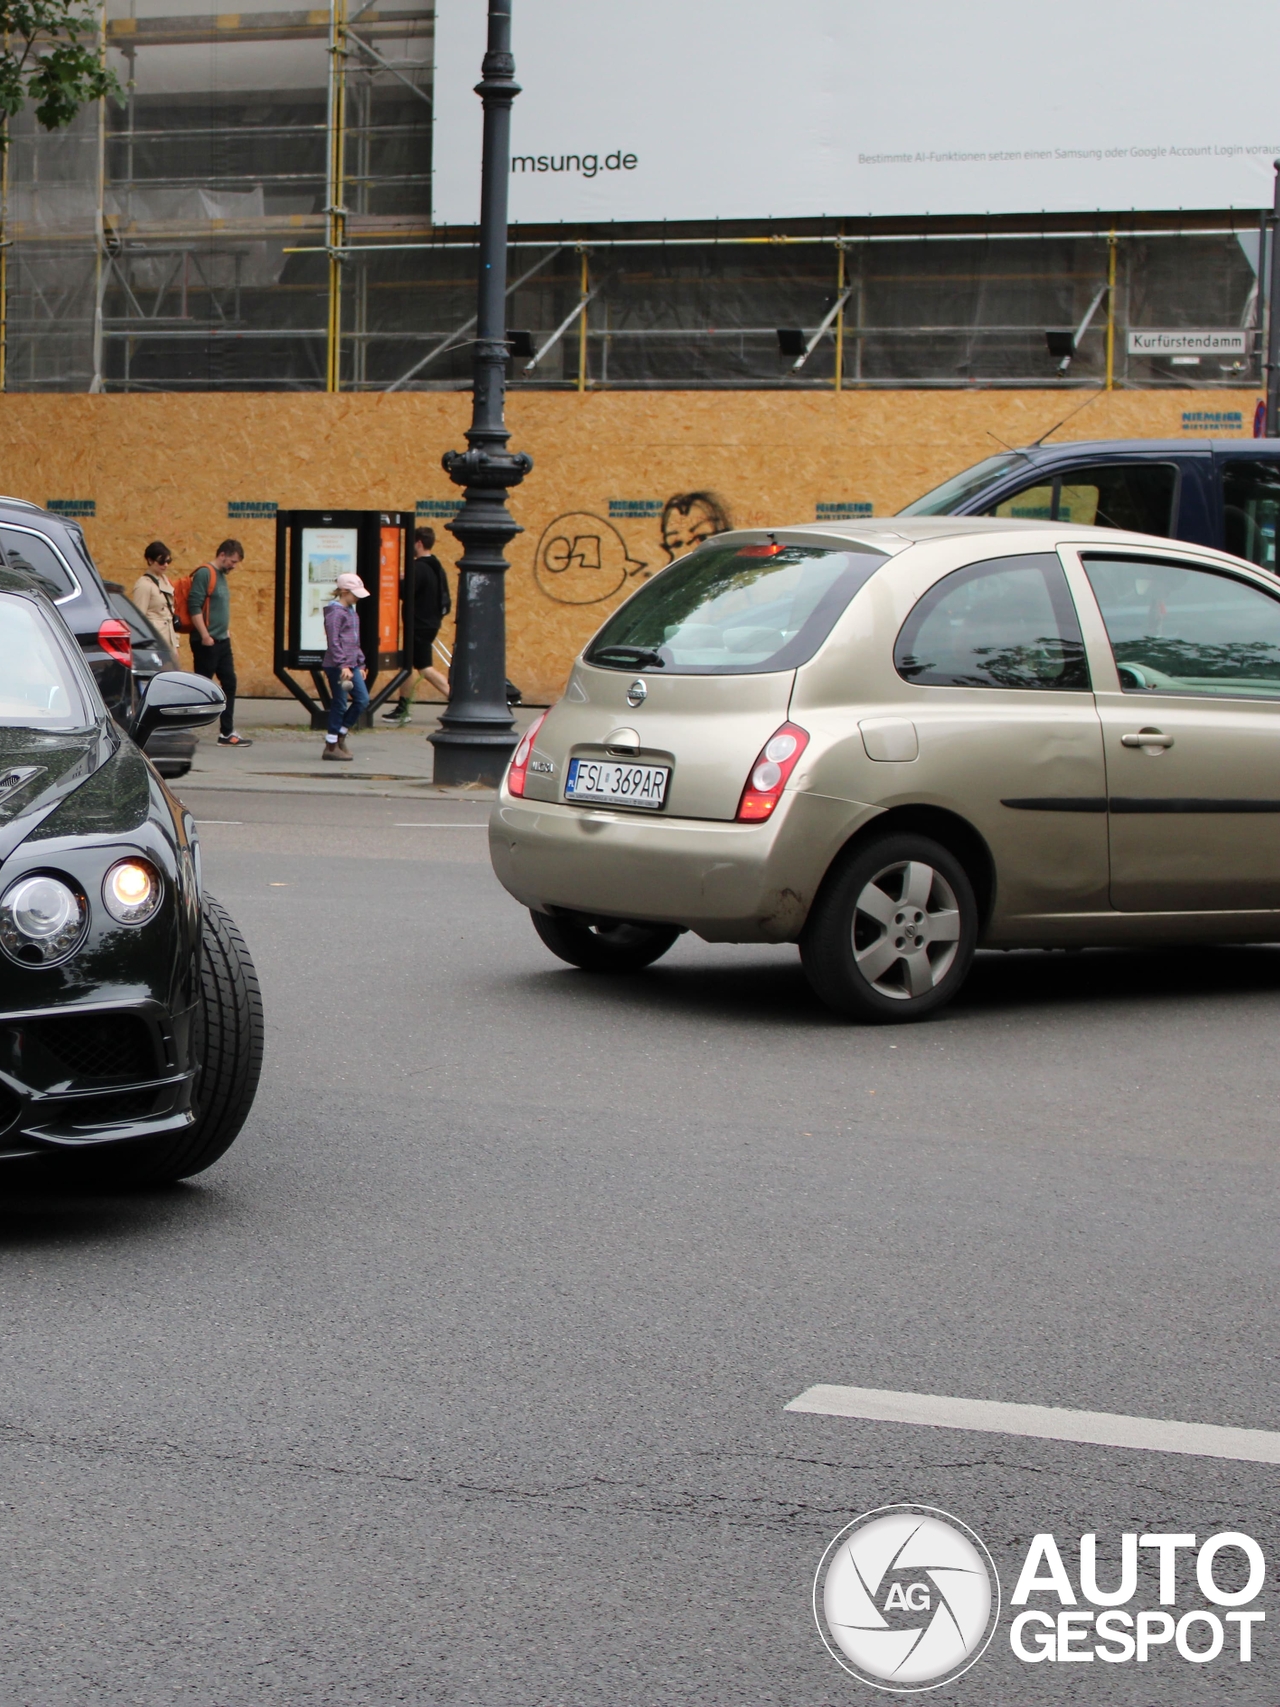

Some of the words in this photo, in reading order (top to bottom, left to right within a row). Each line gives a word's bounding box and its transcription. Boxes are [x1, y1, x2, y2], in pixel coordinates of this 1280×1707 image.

[858, 153, 913, 164] Bestimmte
[914, 151, 986, 162] AI-Funktionen
[988, 151, 1021, 161] setzen
[1024, 150, 1052, 160] einen
[1055, 148, 1103, 161] Samsung
[1104, 147, 1128, 159] oder
[1130, 146, 1167, 160] Google
[1169, 145, 1211, 157] Account
[1214, 145, 1244, 158] Login
[511, 150, 638, 178] msung.de
[1133, 335, 1242, 348] Kurfürstendamm
[1182, 412, 1242, 422] NIEMEIER
[228, 501, 278, 511] NIEMEIER
[568, 779, 575, 788] PL
[575, 763, 604, 793] FSL
[611, 767, 665, 799] 369AR
